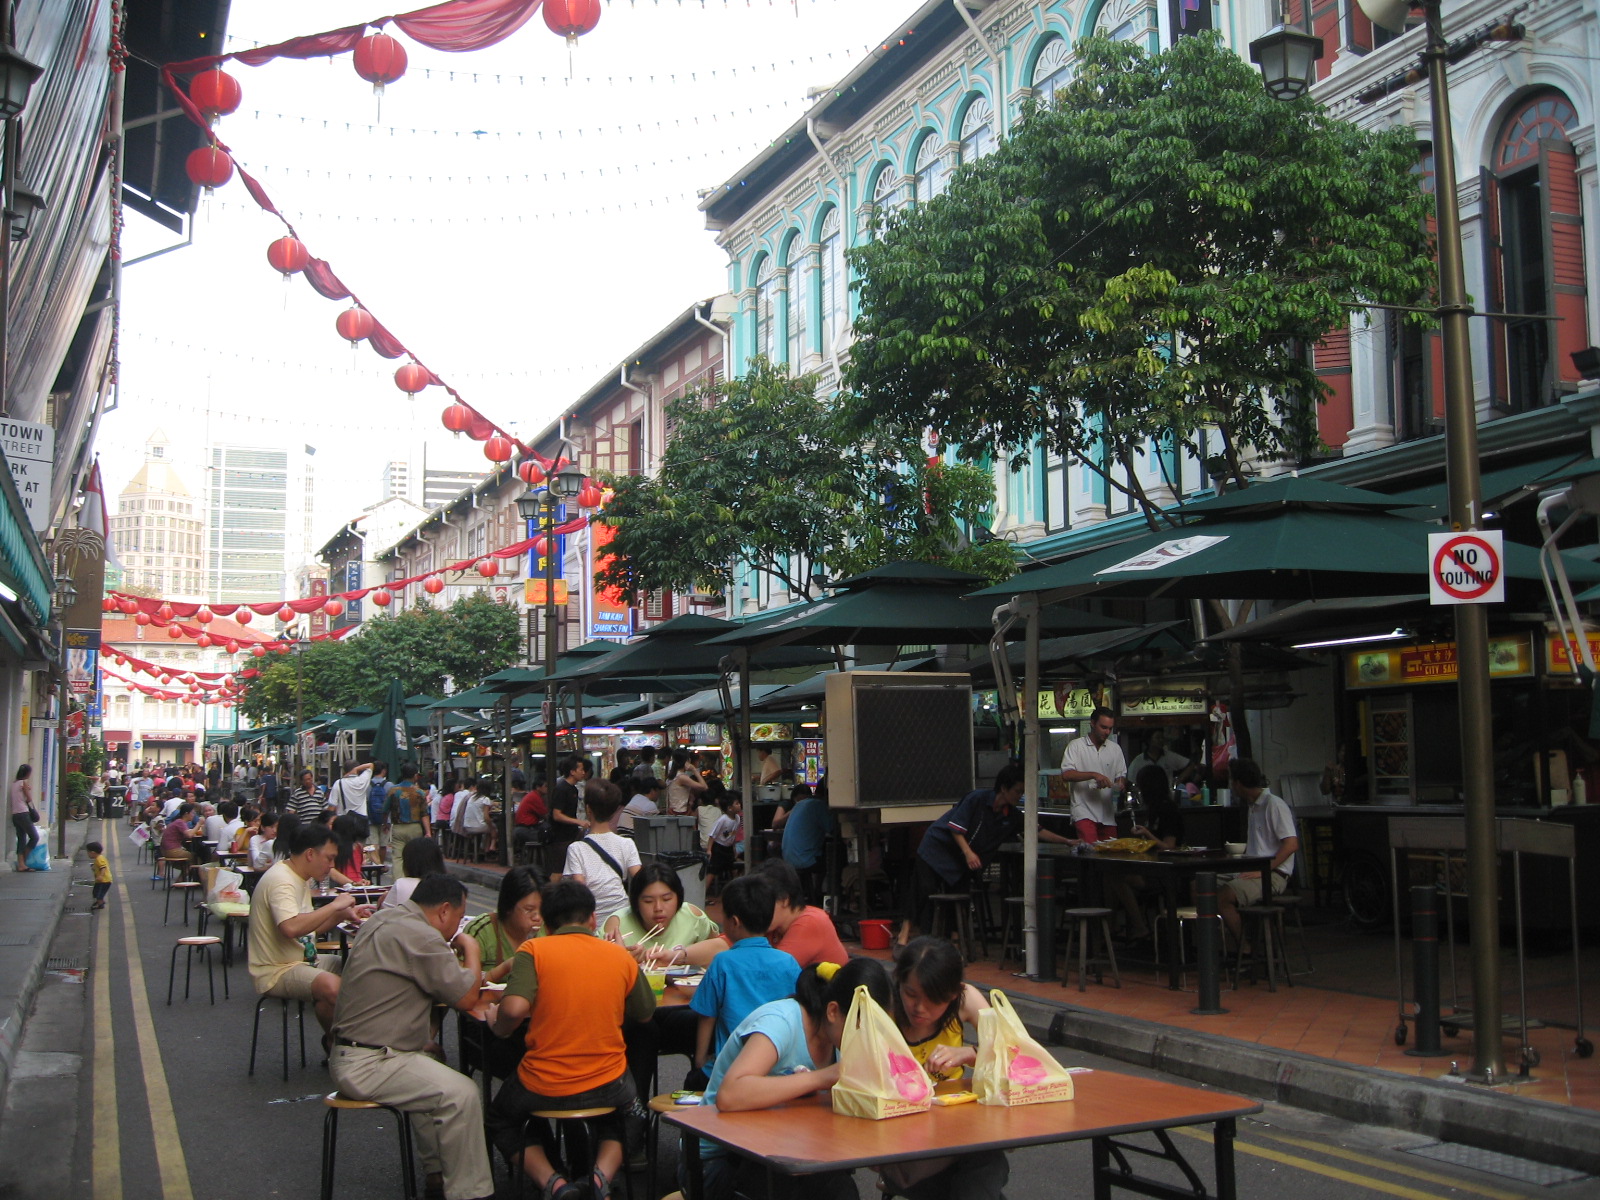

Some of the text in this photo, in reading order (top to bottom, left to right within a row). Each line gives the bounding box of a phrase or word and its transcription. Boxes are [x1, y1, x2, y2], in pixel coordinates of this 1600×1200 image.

[1454, 549, 1478, 565] NO
[1440, 570, 1494, 586] TOUTING
[1425, 665, 1440, 675] CITY
[111, 796, 124, 808] 22
